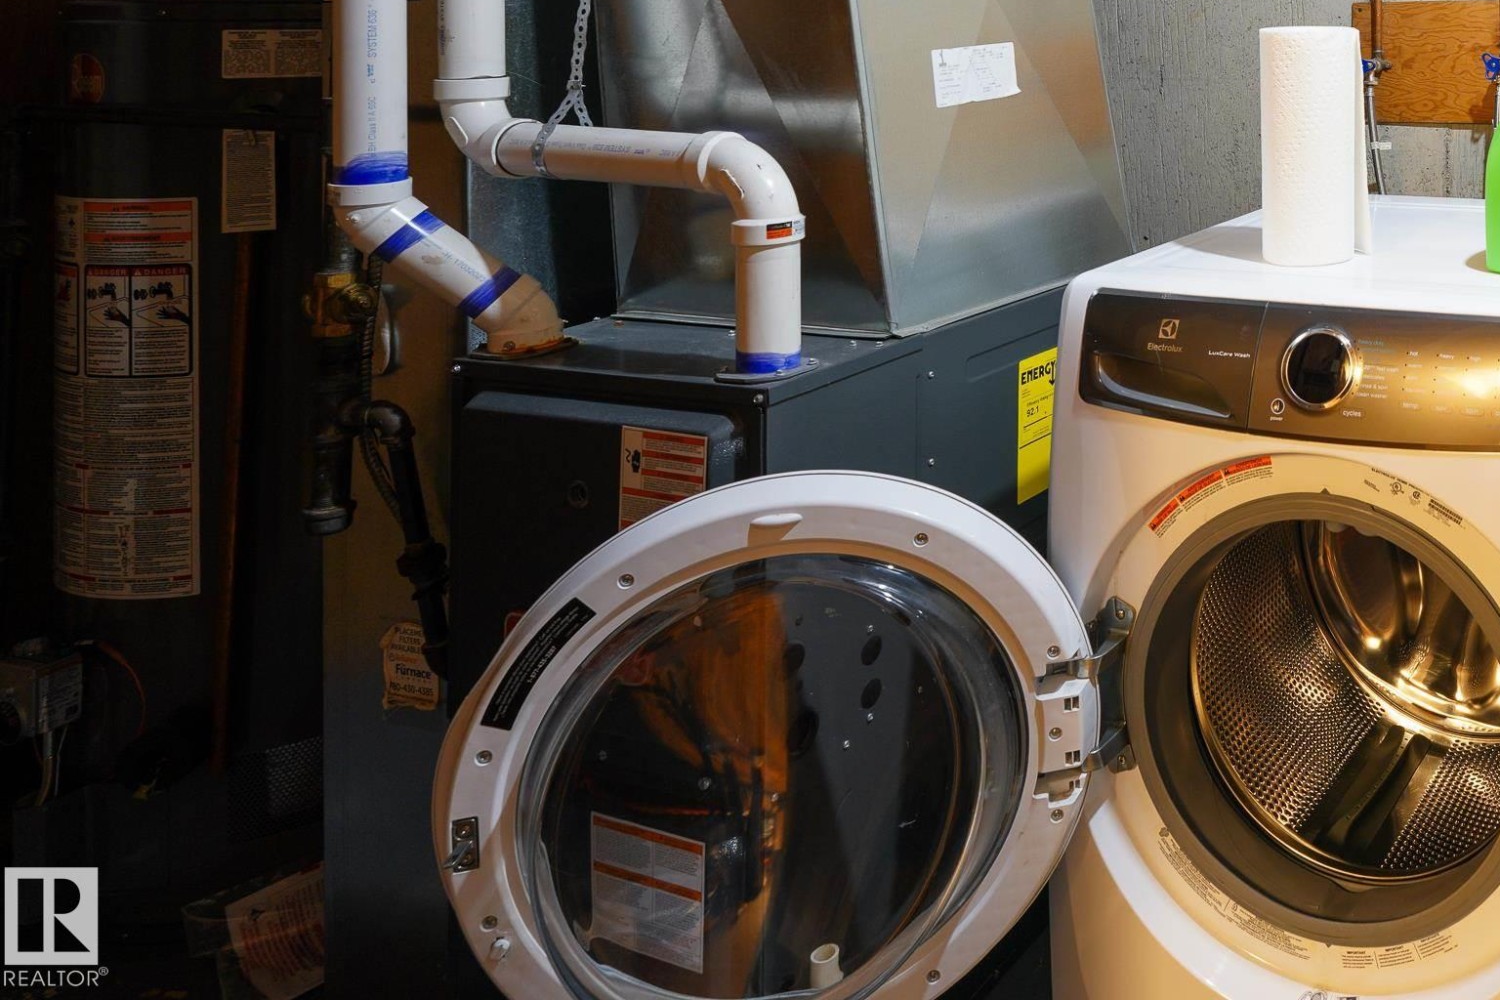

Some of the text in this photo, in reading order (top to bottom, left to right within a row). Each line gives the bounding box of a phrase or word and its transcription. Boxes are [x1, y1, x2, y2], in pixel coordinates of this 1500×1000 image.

[366, 9, 376, 24] 636
[366, 26, 376, 58] SYSTEM
[144, 267, 187, 276] DANGER
[1146, 342, 1183, 353] Electrolux
[1026, 405, 1040, 418] 92.1
[1342, 410, 1362, 418] cycles
[396, 662, 432, 679] Furnace
